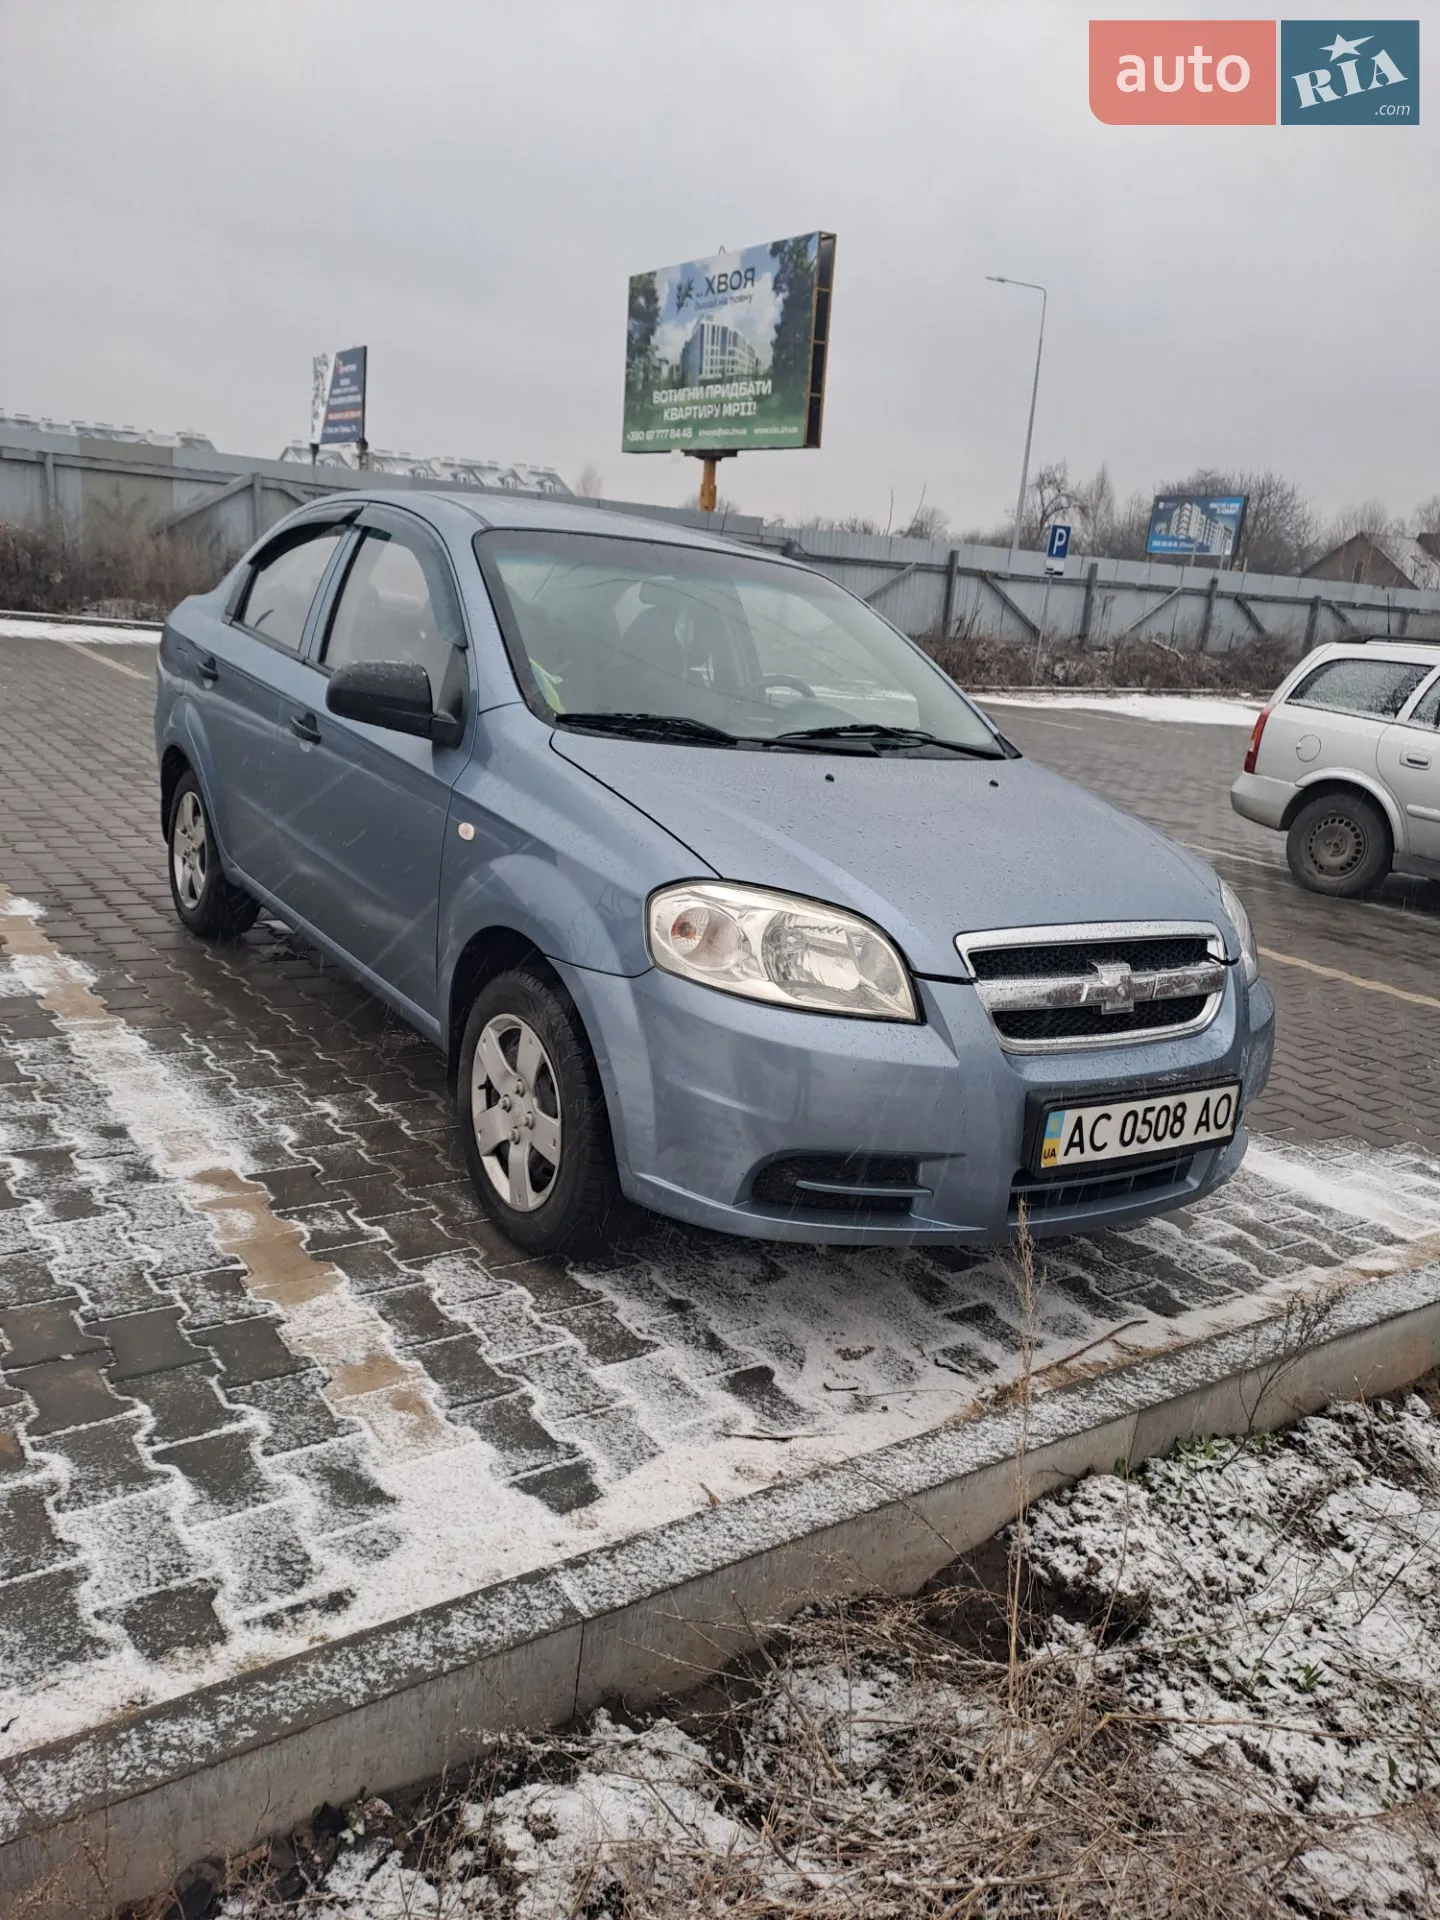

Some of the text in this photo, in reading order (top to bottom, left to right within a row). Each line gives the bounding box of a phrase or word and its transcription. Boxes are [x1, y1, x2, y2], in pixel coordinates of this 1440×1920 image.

[704, 267, 755, 297] ХВОЯ
[705, 379, 773, 400] ПРИДБАТИ
[662, 404, 721, 421] КВАРТИРУ
[1052, 528, 1067, 555] P
[1064, 1093, 1232, 1157] AC 0508 AO
[1043, 1147, 1056, 1160] UA
